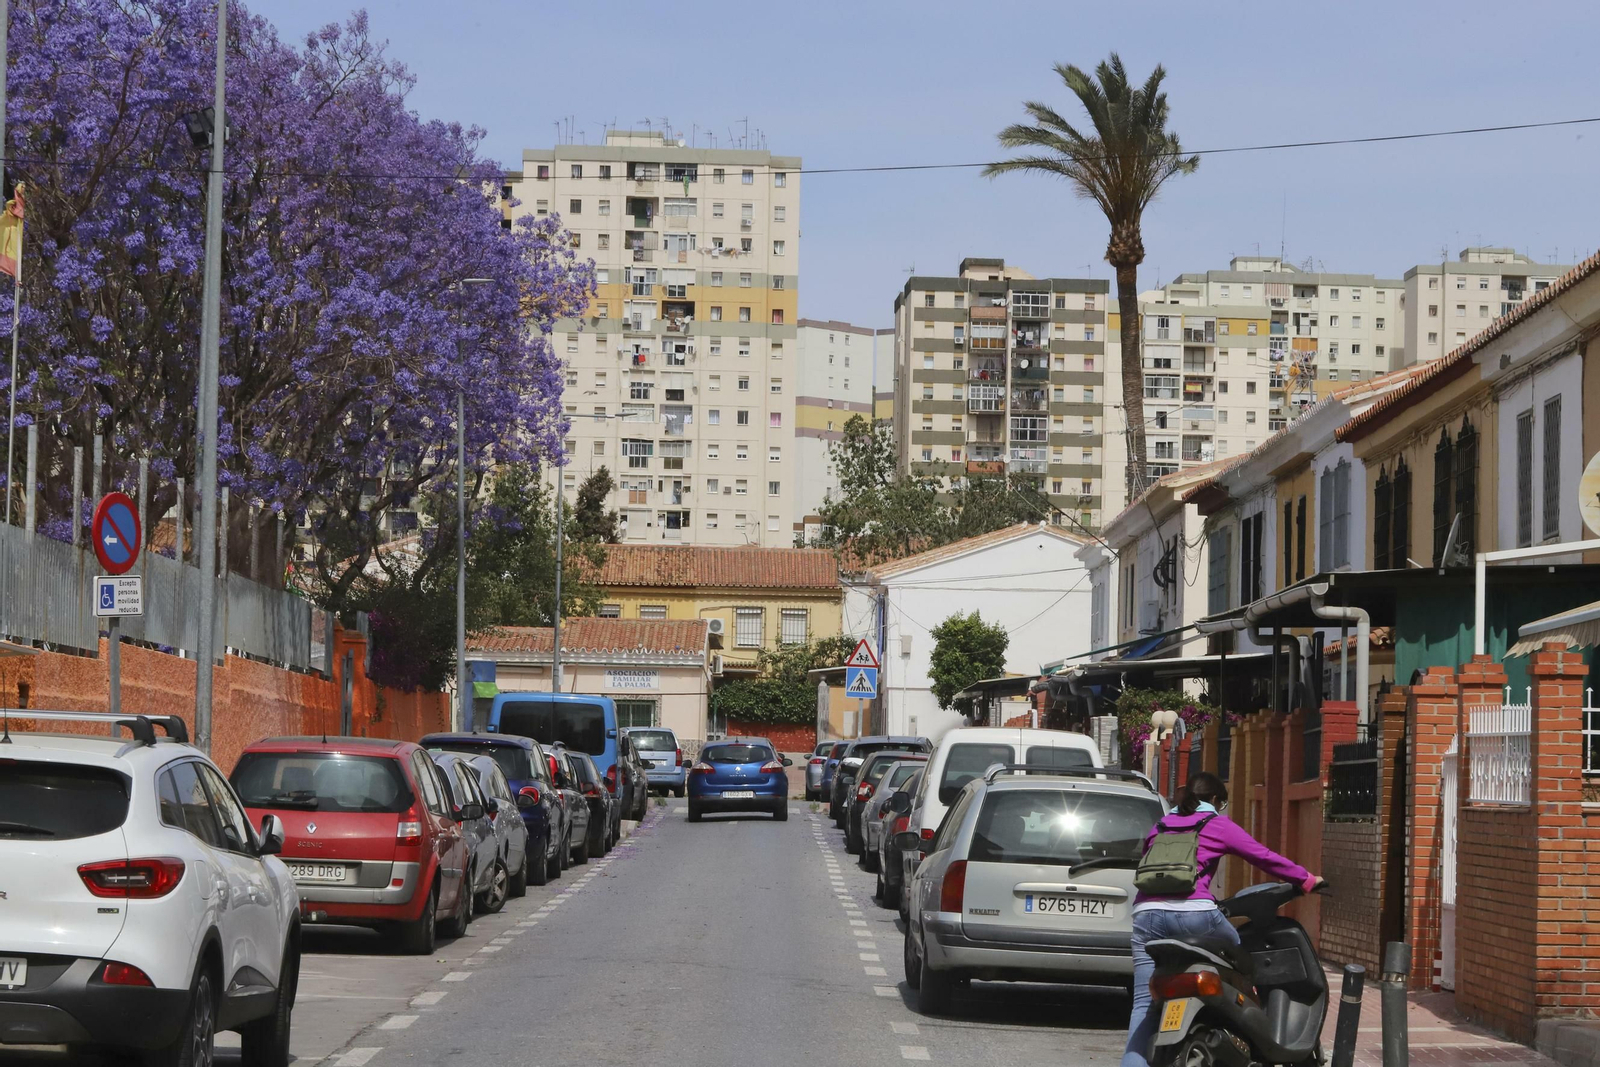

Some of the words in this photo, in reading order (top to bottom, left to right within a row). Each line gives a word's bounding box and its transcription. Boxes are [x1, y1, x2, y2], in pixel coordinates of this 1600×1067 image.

[287, 864, 314, 877] 289
[318, 865, 342, 878] DRG
[969, 907, 1001, 917] RENAULT
[1038, 896, 1076, 913] 6765
[1081, 898, 1108, 915] HZY
